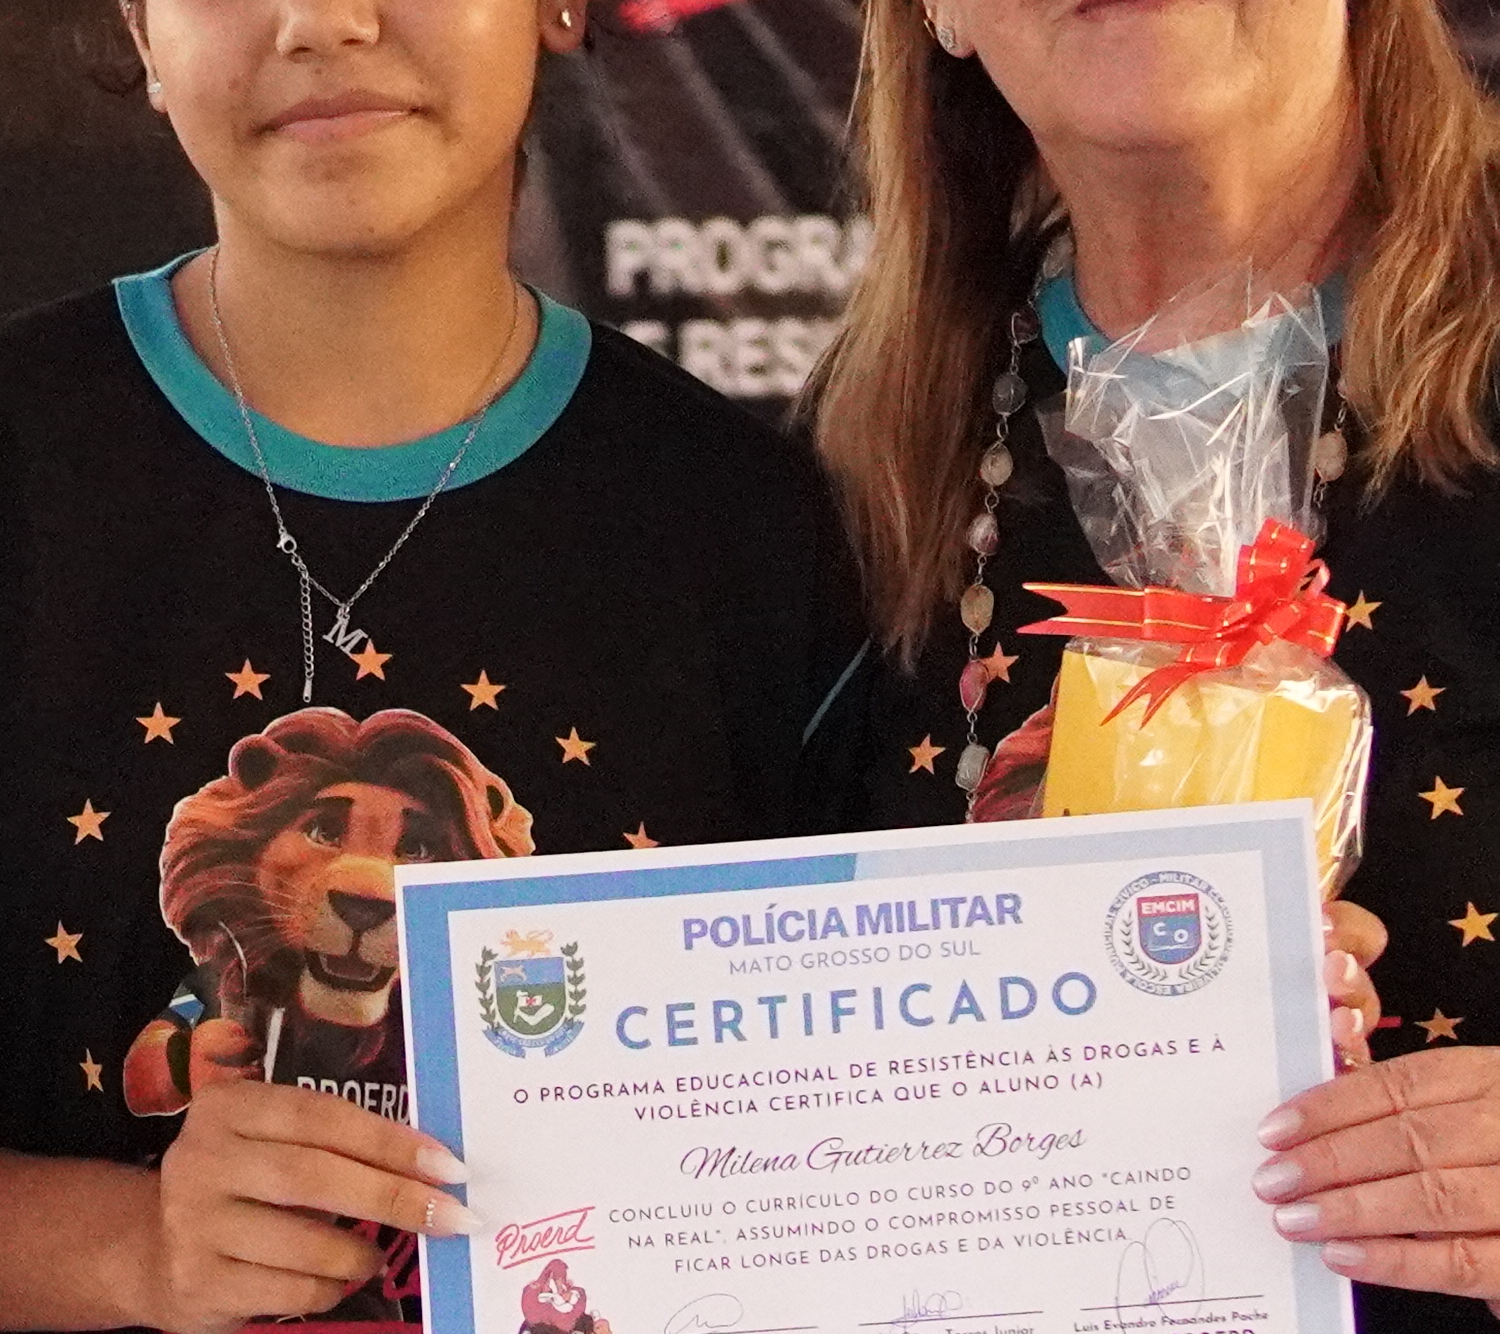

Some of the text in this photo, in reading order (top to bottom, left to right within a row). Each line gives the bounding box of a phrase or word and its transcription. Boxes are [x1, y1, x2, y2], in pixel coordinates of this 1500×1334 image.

[683, 893, 1023, 951] POLÍCIA MILITAR
[1140, 899, 1195, 915] EMCIM
[729, 939, 980, 975] MATO GROSSO DO SUL
[615, 971, 1097, 1051] CERTIFICADO
[514, 1033, 1226, 1104] O PROGRAMA EDUCACIONAL DE RESISTÊNCIA ÀS DROGAS E À
[634, 1071, 1103, 1121] VIOLÊNCIA CERTIFICA QUE O ALUNO (A)
[680, 1122, 1089, 1180] Milena Gutierrez Borges
[608, 1202, 713, 1225] CONCLUIU
[721, 1201, 737, 1216] O
[745, 1190, 861, 1215] CURRÍCULO
[869, 1188, 899, 1205] DO
[907, 1182, 975, 1202] CURSO
[984, 1179, 1014, 1196] DO
[1048, 1173, 1094, 1190] ANO
[627, 1233, 656, 1249] NA
[736, 1219, 856, 1242] ASSUMINDO
[865, 1217, 880, 1233] O
[888, 1204, 1041, 1231] COMPROMISSO
[1049, 1198, 1140, 1219] PESSOAL
[1149, 1195, 1176, 1211] DE
[495, 1207, 596, 1268] Proerd
[674, 1254, 732, 1274] FICAR
[741, 1250, 811, 1270] LONGE
[819, 1246, 858, 1265] DAS
[866, 1240, 949, 1261] DROGAS
[957, 1237, 968, 1253] E
[978, 1235, 1005, 1252] DA
